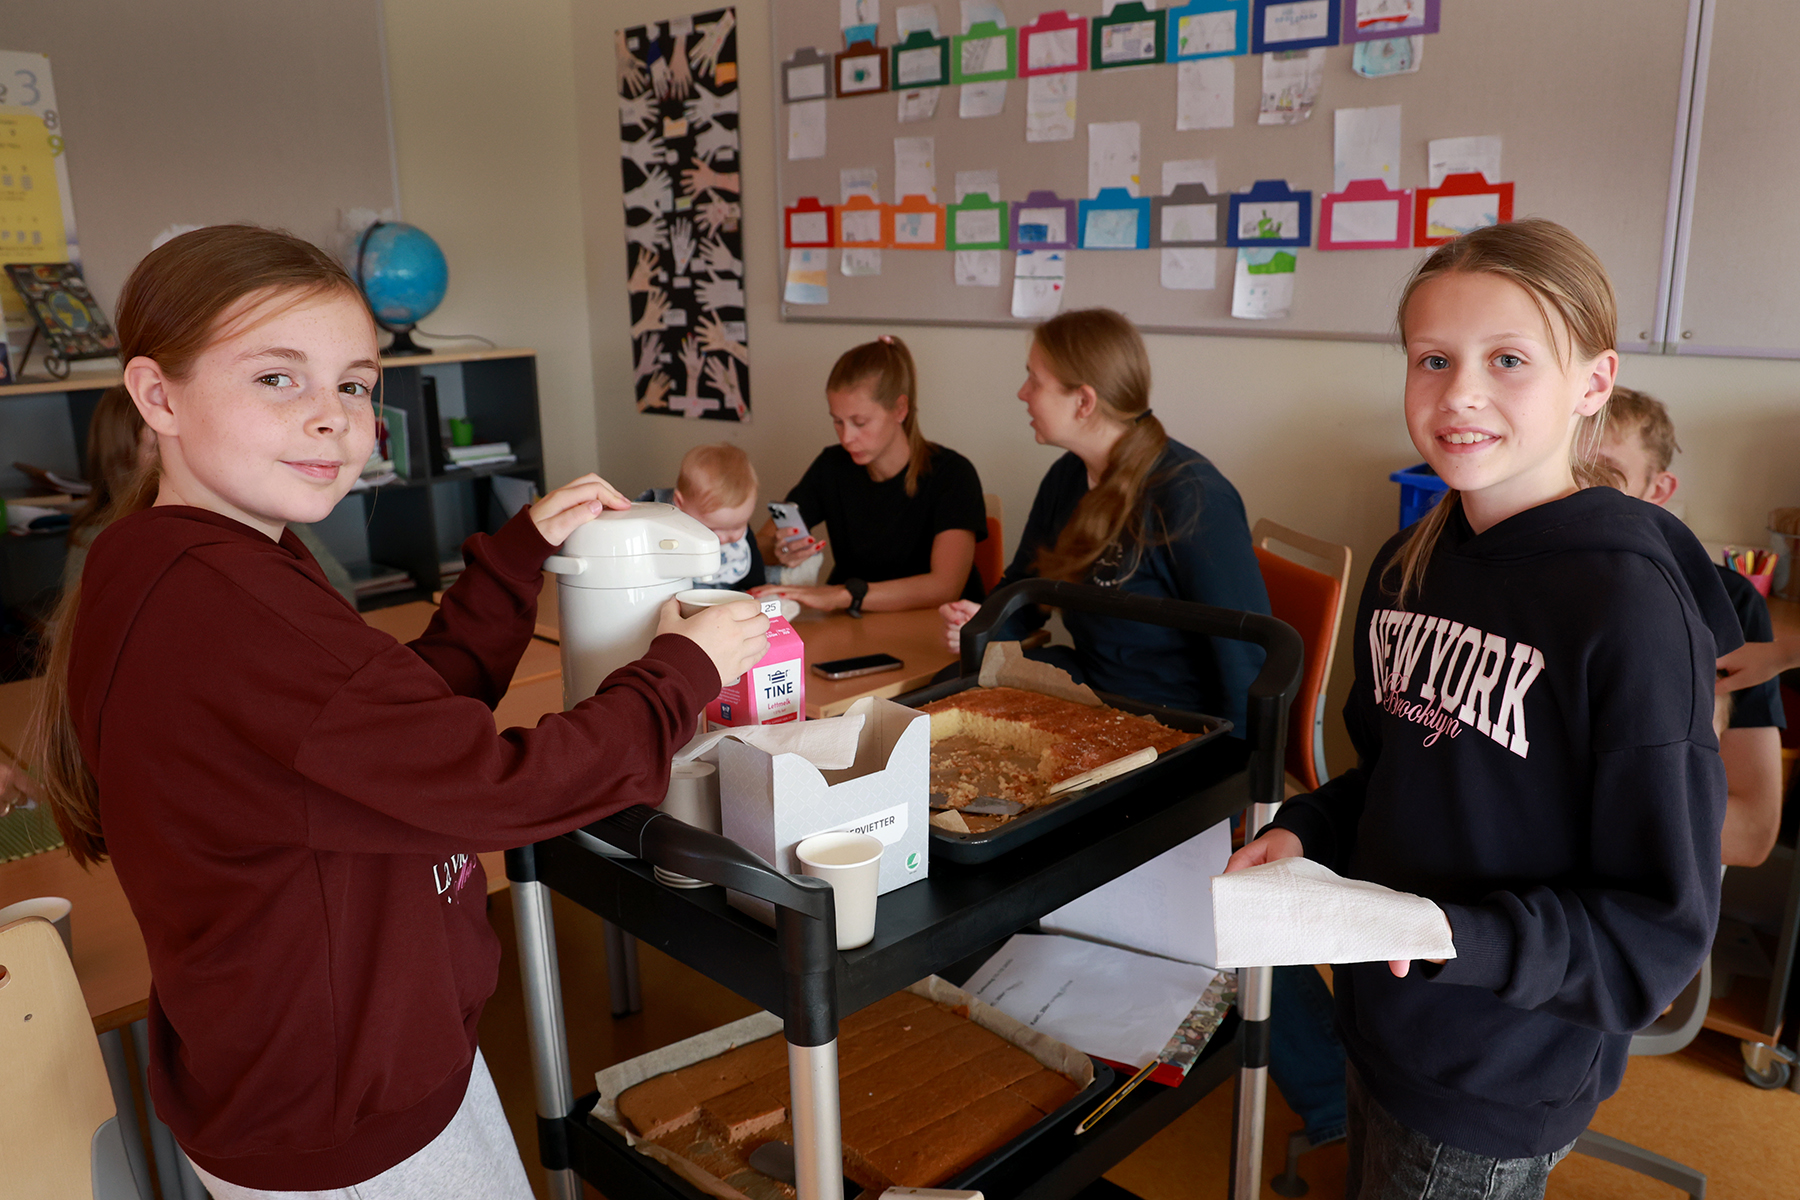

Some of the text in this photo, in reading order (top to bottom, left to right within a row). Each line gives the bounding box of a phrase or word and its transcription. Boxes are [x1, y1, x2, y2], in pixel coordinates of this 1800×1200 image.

[14, 70, 40, 106] 3
[43, 109, 58, 130] 8
[764, 602, 777, 613] 25
[764, 681, 794, 699] TINE
[1369, 609, 1546, 759] NEW YORK
[1383, 672, 1463, 748] Brooklyn
